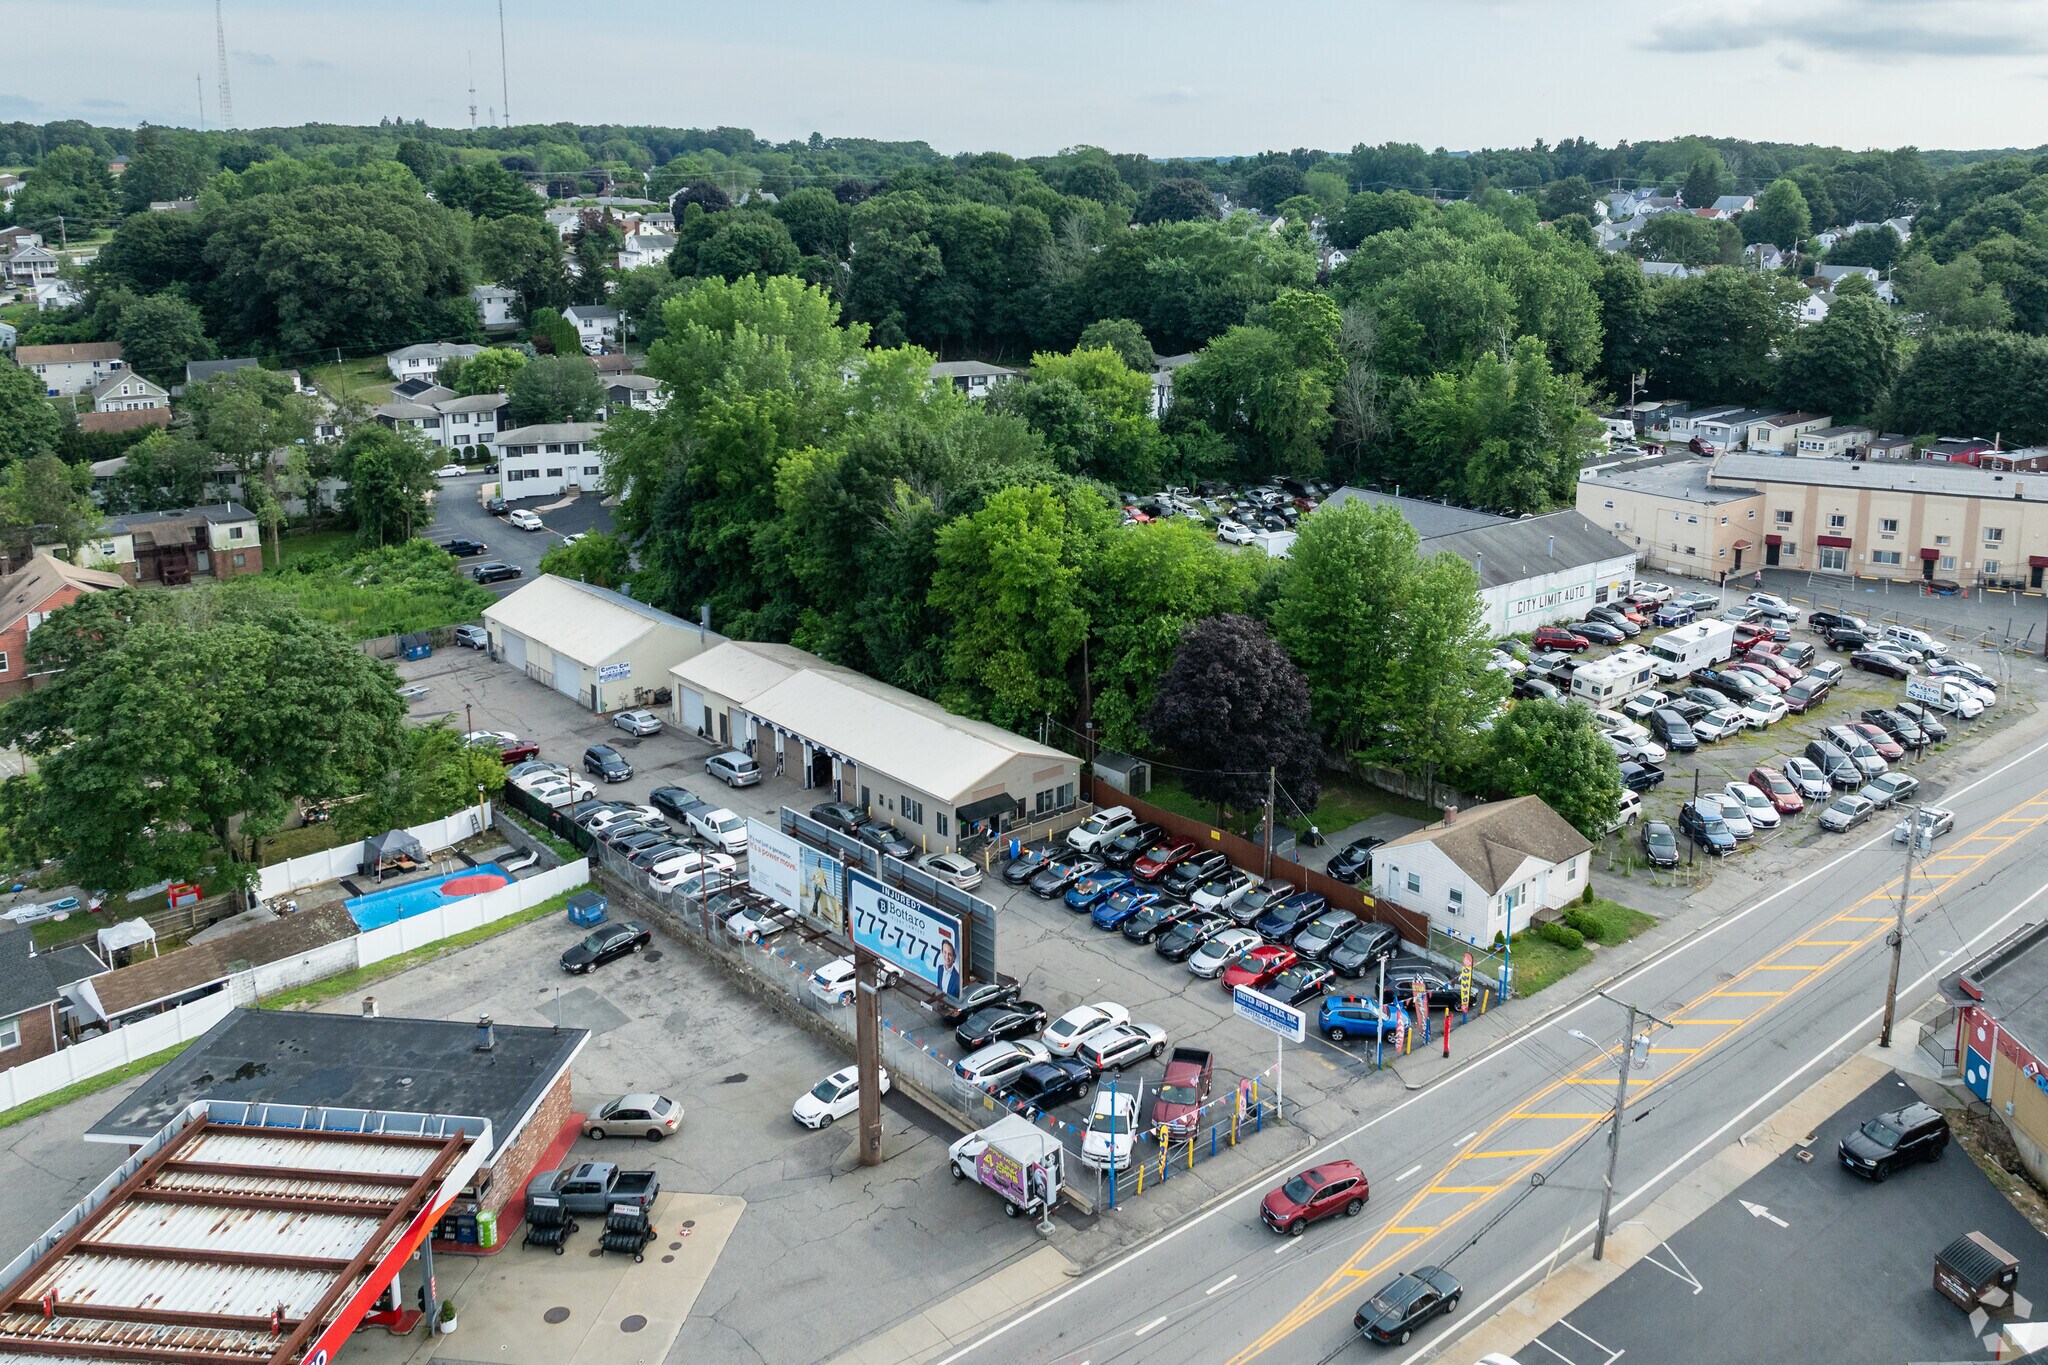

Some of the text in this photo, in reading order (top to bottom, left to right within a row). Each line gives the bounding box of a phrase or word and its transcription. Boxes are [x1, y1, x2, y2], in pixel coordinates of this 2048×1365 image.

[1517, 586, 1585, 613] CITY LIMIT AUTO
[1909, 683, 1939, 694] Auto
[881, 886, 921, 912] INJURED?
[889, 901, 926, 929] Bottaro
[855, 906, 941, 968] 777-7777
[1236, 990, 1255, 1005] UNITED
[1255, 998, 1269, 1011] AUTO
[1240, 1006, 1262, 1020] CAPITAL
[1272, 1020, 1292, 1033] CENTER
[983, 1154, 994, 1168] 4
